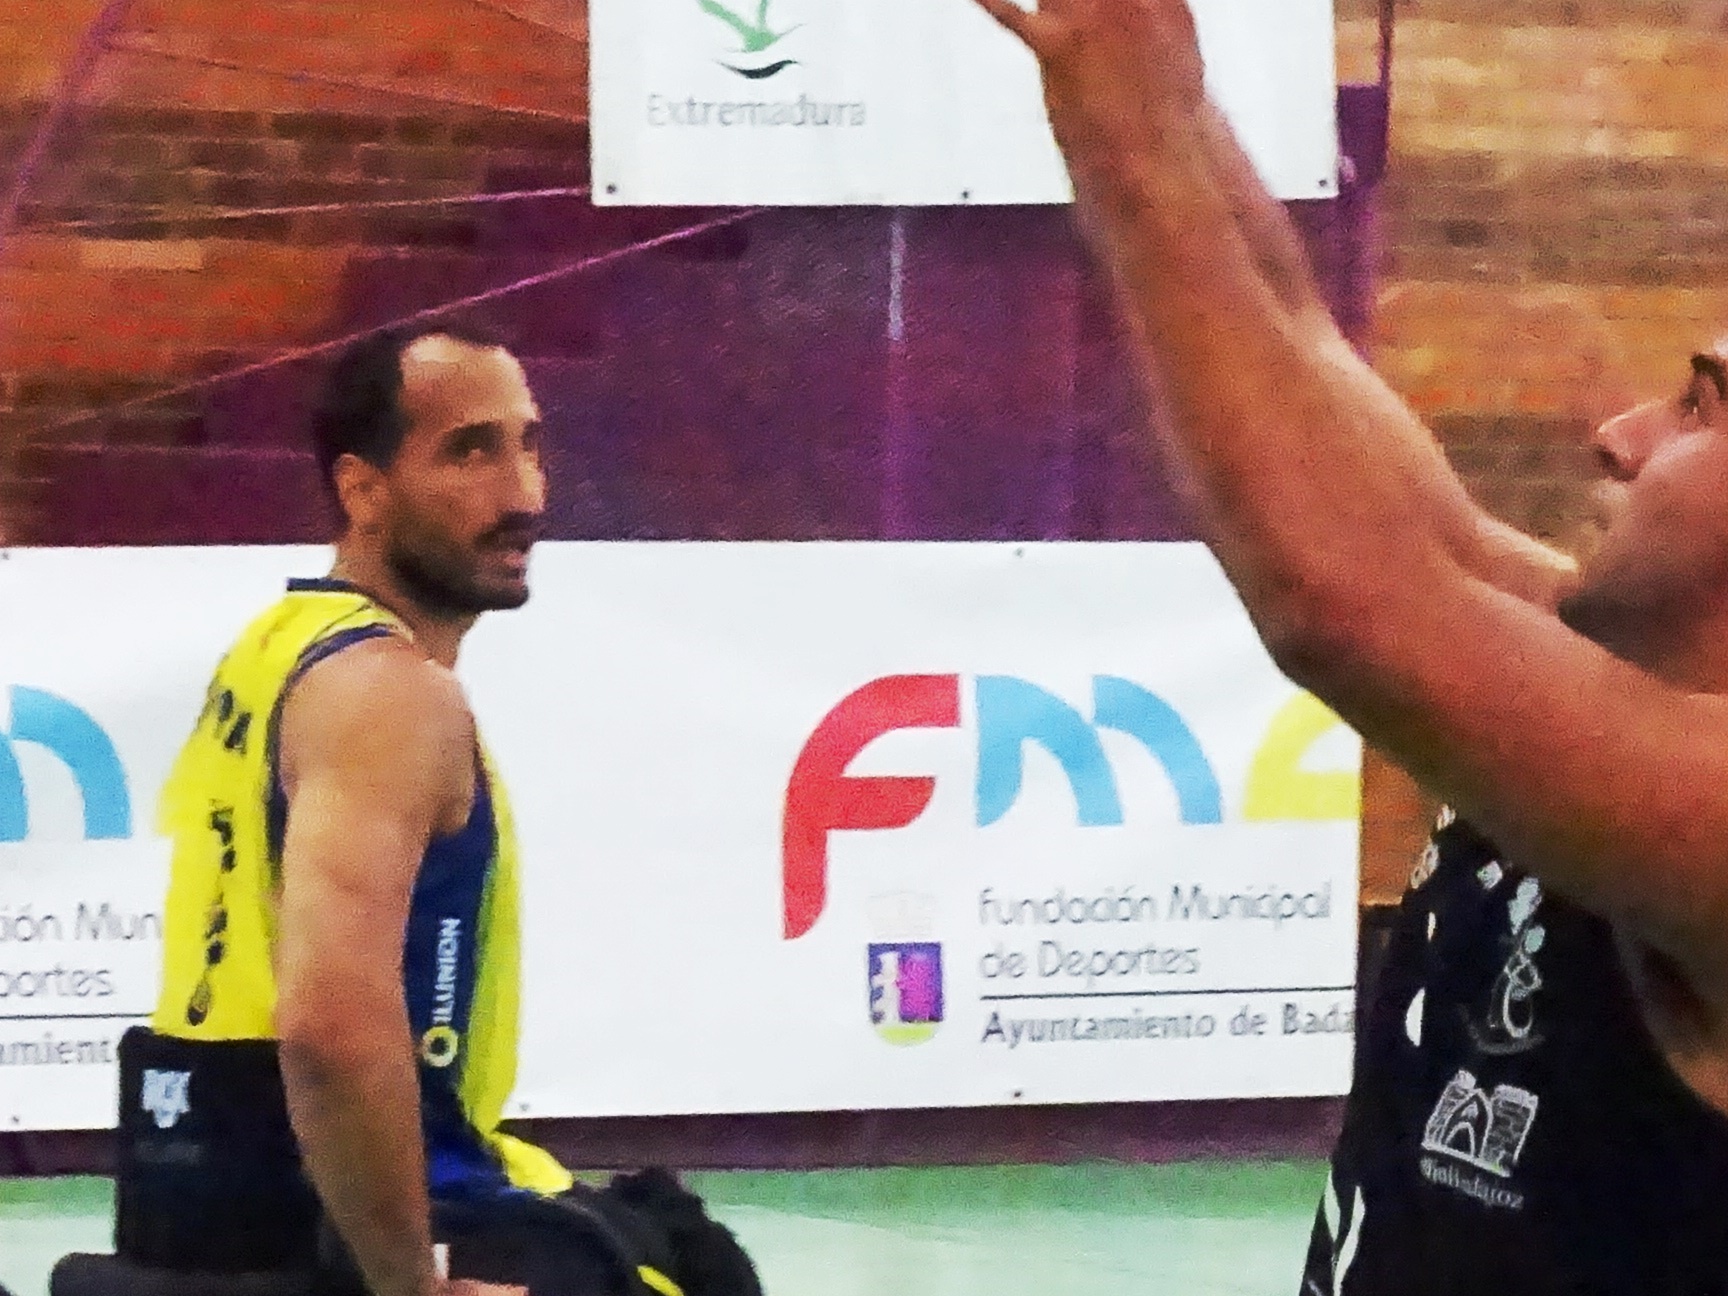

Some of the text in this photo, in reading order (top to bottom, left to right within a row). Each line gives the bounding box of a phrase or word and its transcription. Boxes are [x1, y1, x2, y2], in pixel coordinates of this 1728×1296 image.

[648, 92, 865, 126] Extremadura
[1166, 882, 1332, 930] Municipal
[979, 940, 1201, 988] de Deportes
[981, 1002, 1357, 1049] Ayuntamiento de Bada
